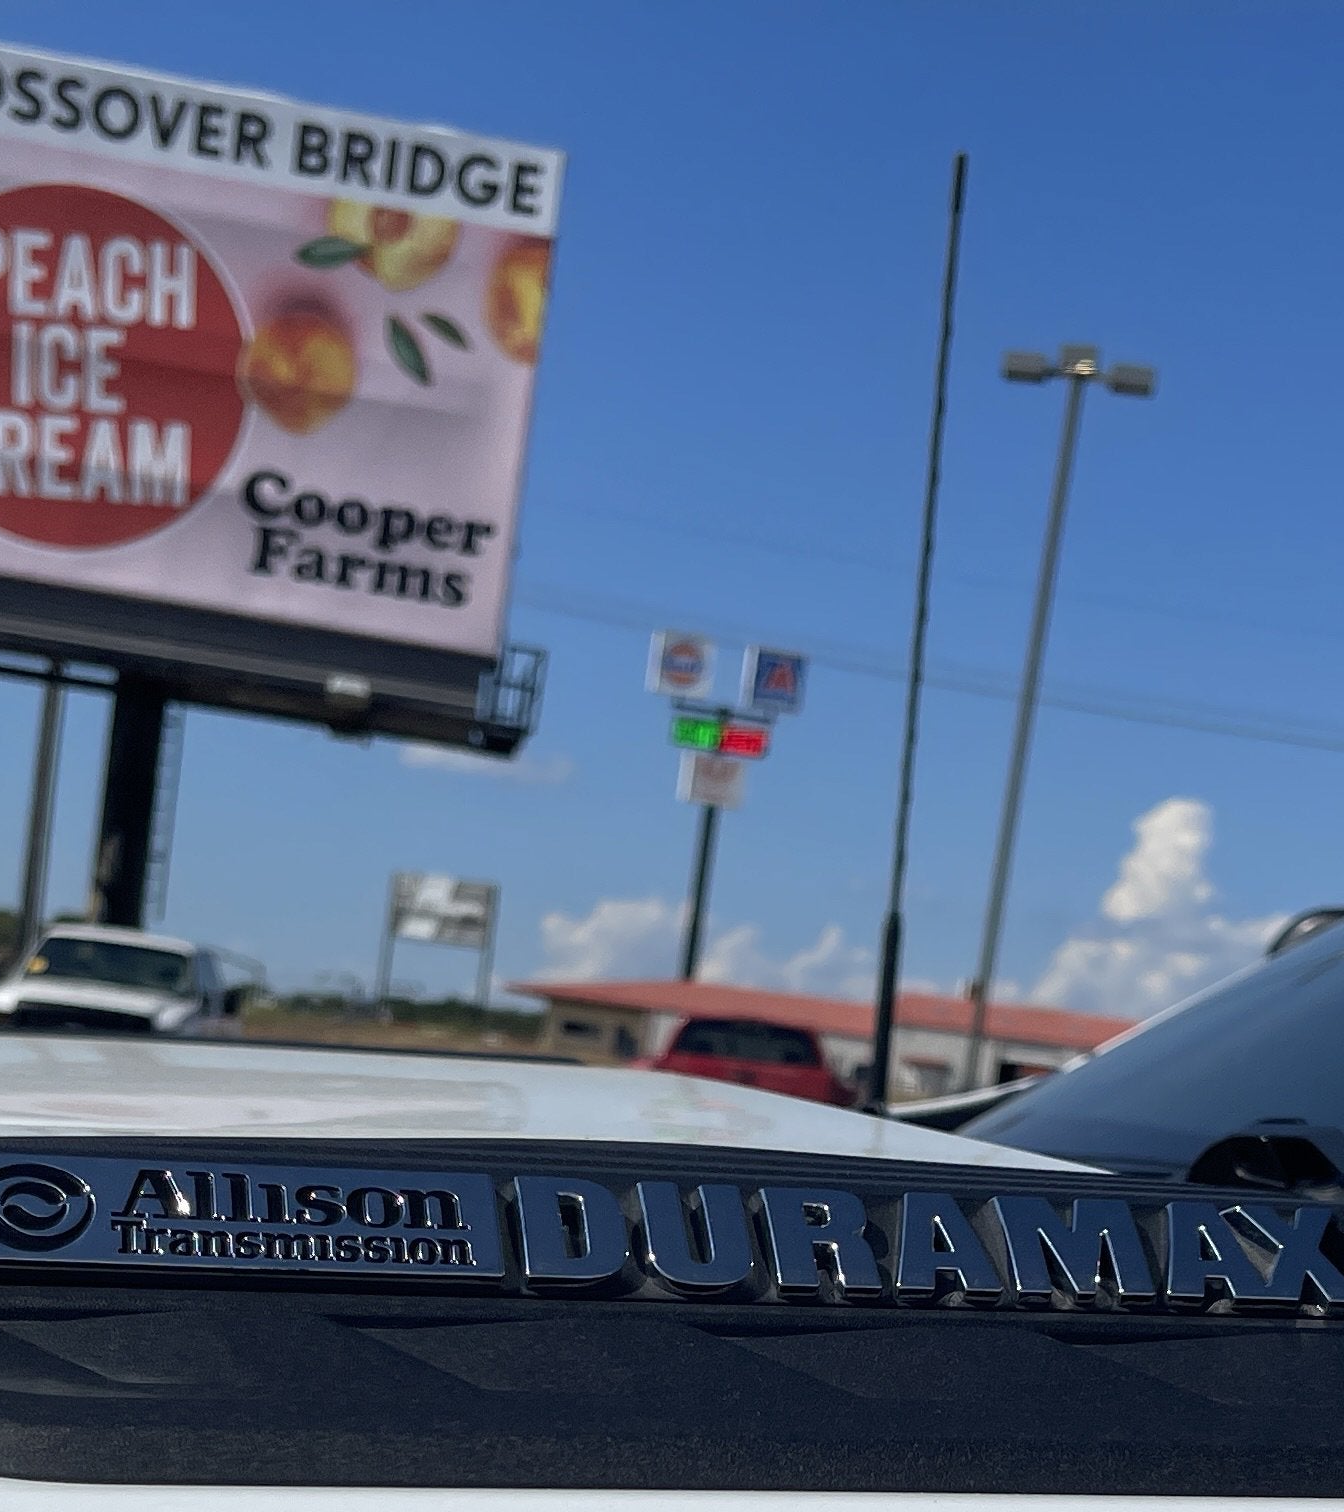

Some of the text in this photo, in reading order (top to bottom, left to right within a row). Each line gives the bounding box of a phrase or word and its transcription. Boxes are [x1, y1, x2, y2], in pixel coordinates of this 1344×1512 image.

[293, 124, 546, 217] BRIDGE
[10, 327, 126, 413] ICE
[244, 470, 498, 558] Cooper
[250, 528, 472, 608] Farms
[111, 1169, 472, 1231] Allison
[112, 1220, 478, 1266] Transmission
